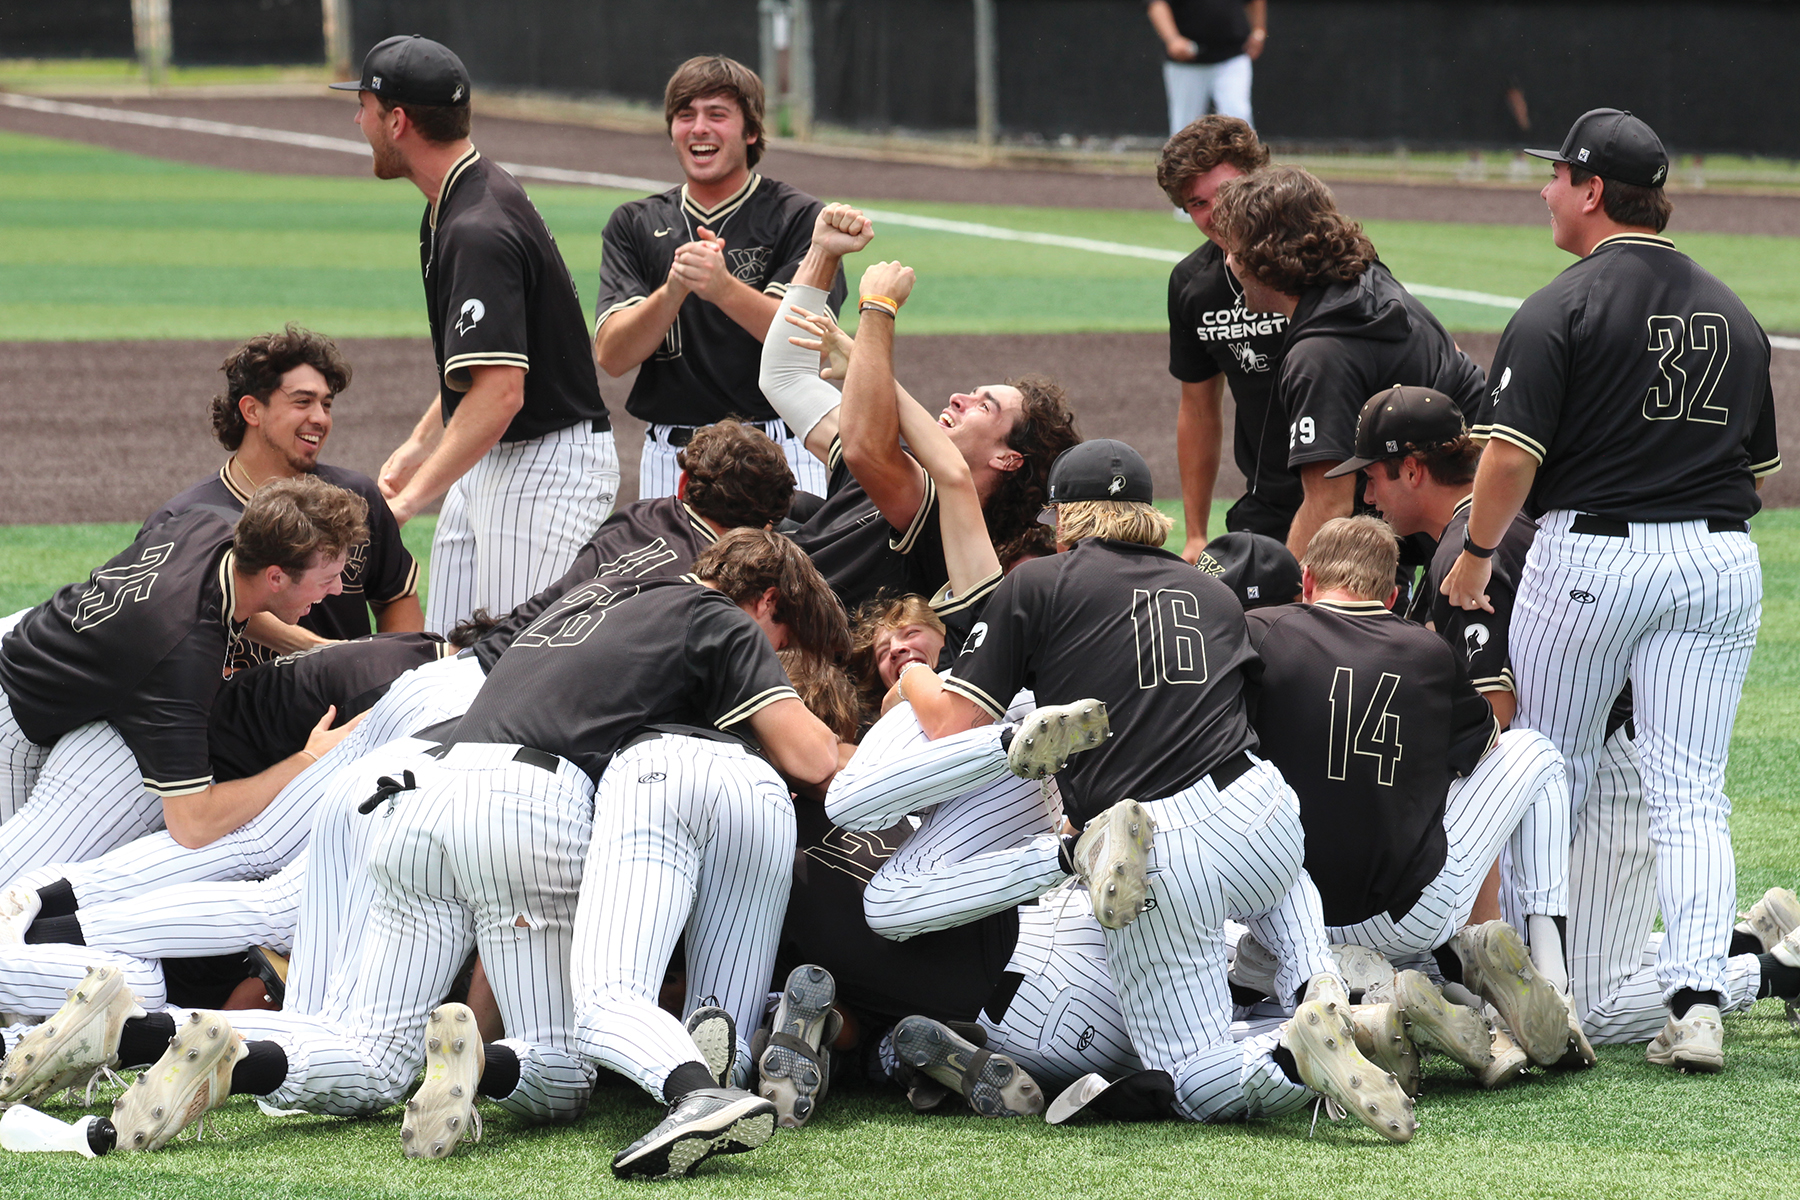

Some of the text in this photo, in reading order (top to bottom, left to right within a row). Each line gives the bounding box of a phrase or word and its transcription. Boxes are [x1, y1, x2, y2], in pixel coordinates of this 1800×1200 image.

[1196, 315, 1291, 342] STRENGT
[1202, 307, 1285, 326] COYO
[1642, 312, 1731, 425] 32
[1131, 588, 1208, 689] 16
[1328, 666, 1403, 786] 14
